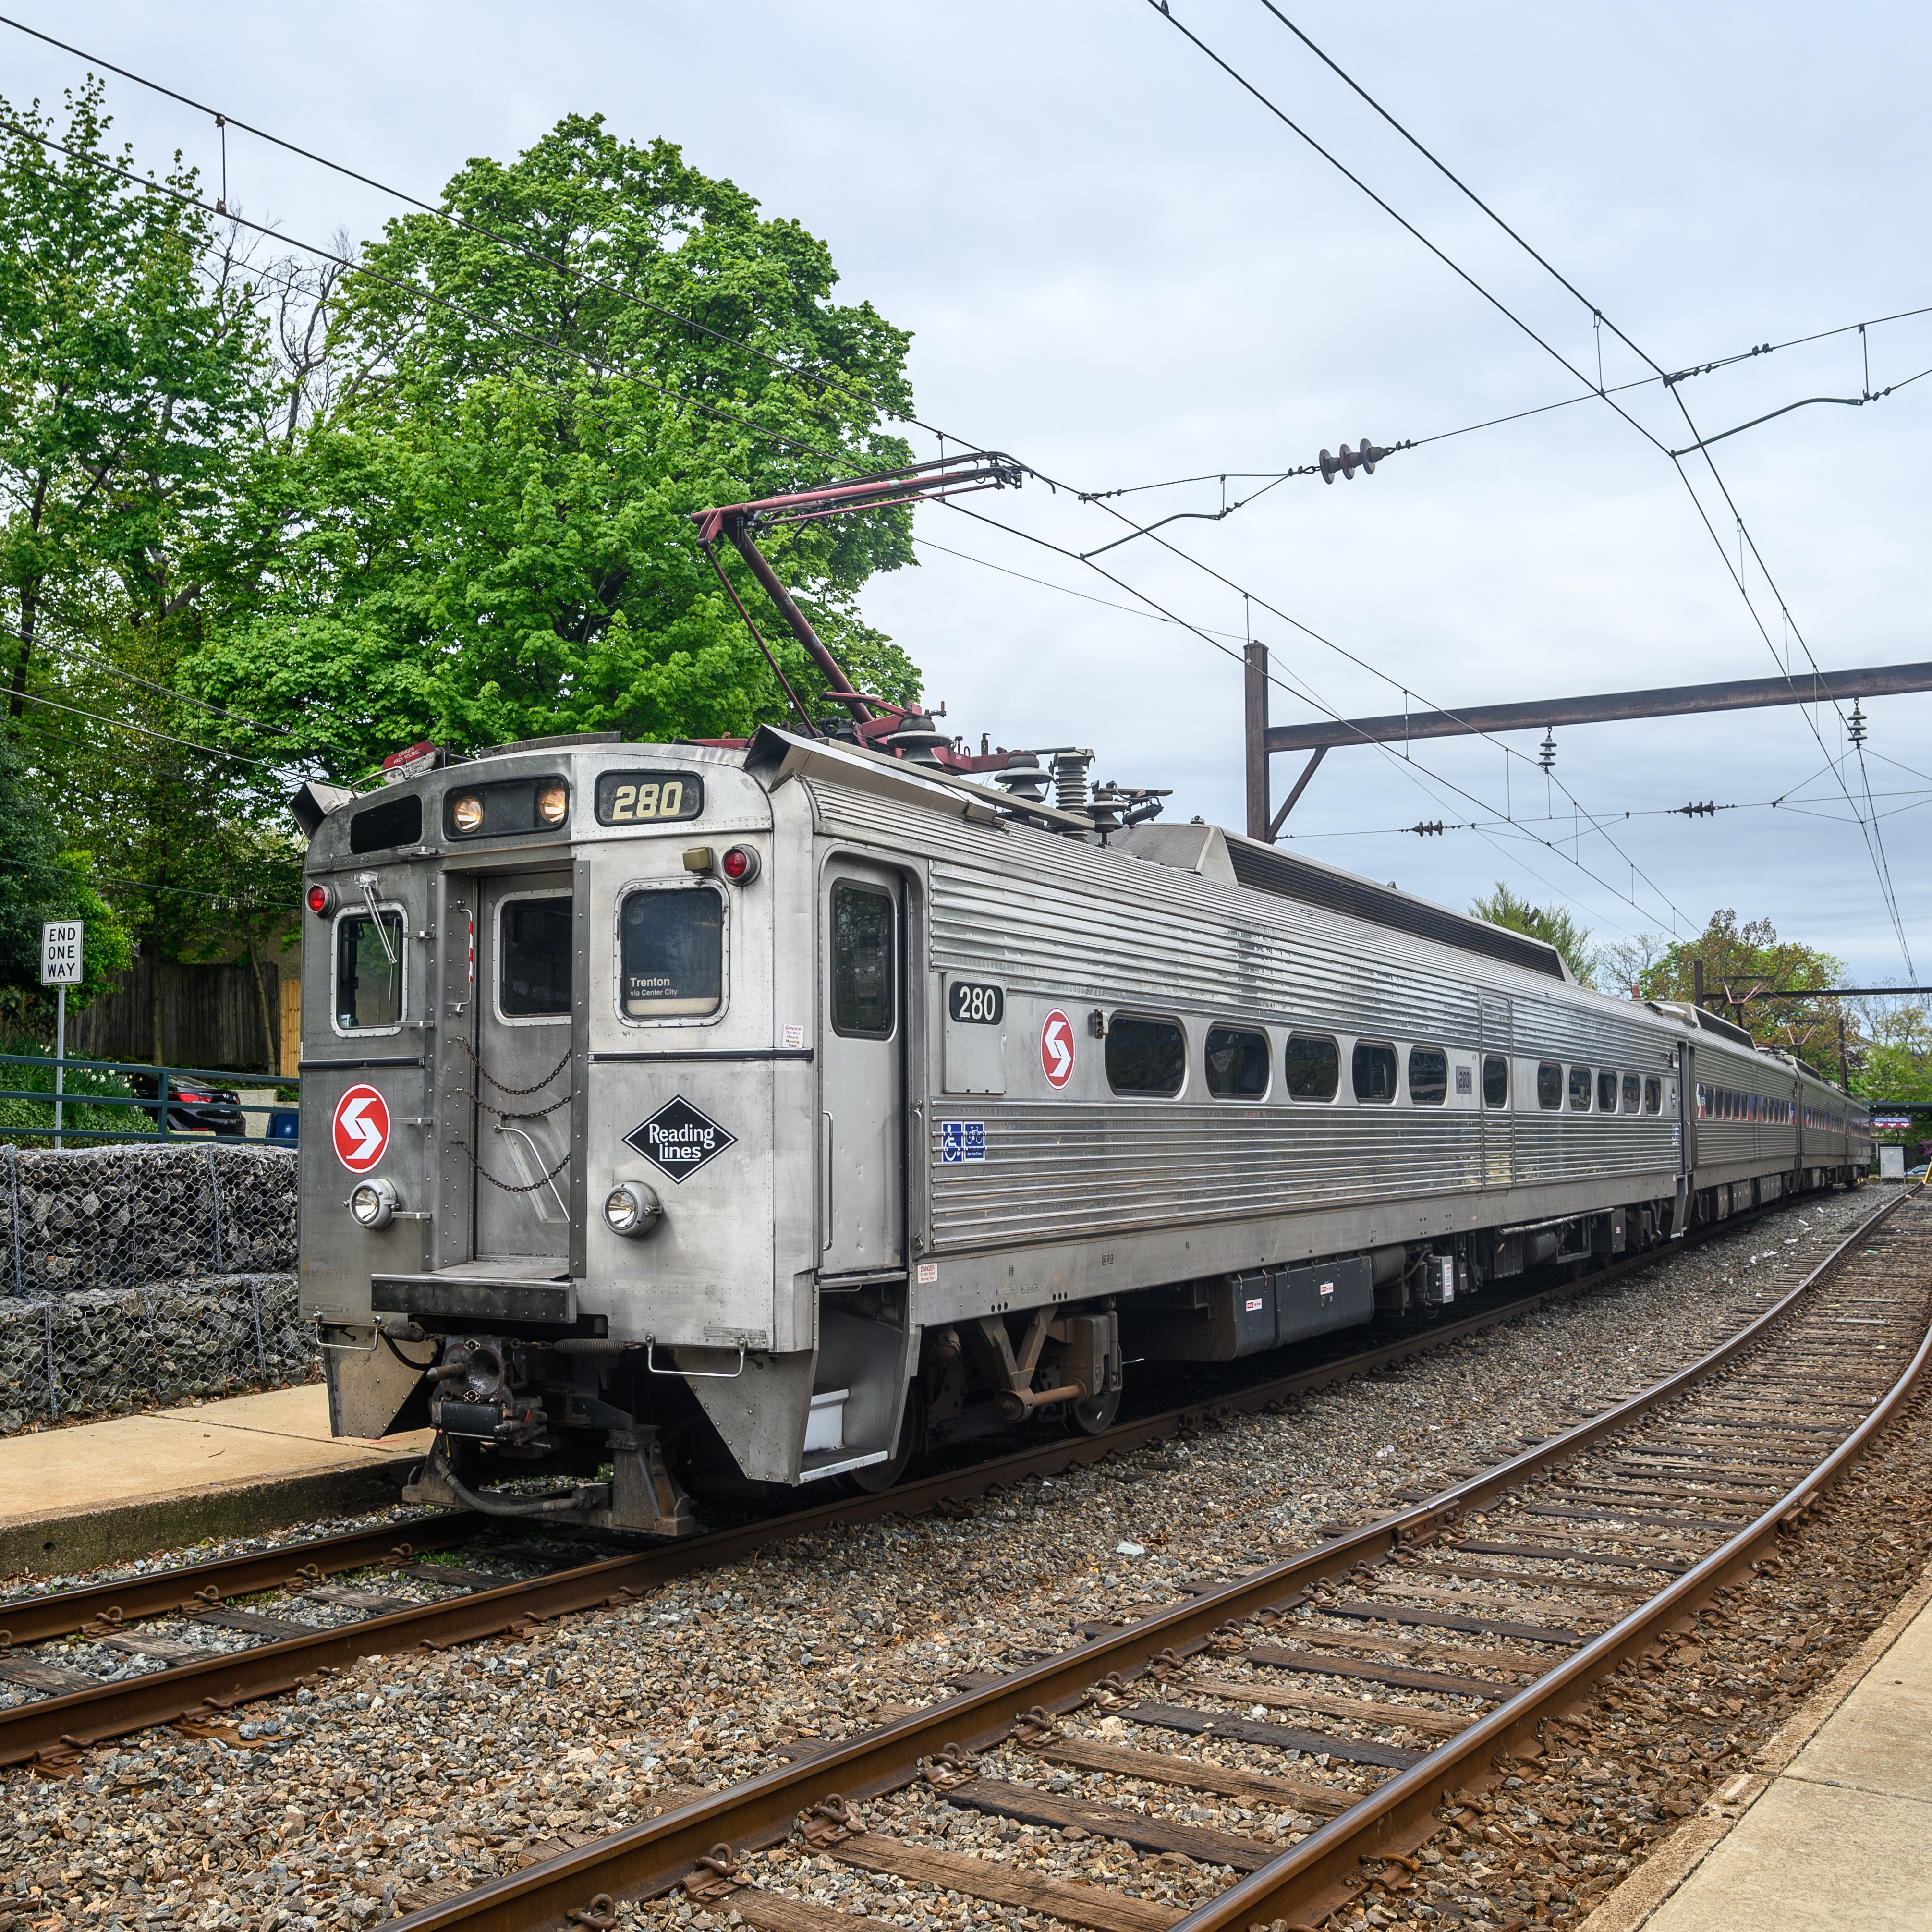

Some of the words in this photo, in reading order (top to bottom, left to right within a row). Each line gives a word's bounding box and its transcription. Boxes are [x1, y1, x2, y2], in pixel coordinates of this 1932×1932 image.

[393, 756, 404, 765] HIGH
[404, 749, 421, 760] VOLTAGE
[398, 747, 414, 757] DANGER
[612, 781, 683, 820] 280
[49, 927, 75, 942] END
[48, 945, 74, 960] ONE
[48, 963, 75, 977] WAY
[630, 977, 670, 987] Trenton
[959, 986, 996, 1021] 280
[1459, 1071, 1470, 1088] 280
[649, 1124, 715, 1149] Reading
[659, 1142, 701, 1161] Lines
[1104, 1254, 1114, 1263] 280
